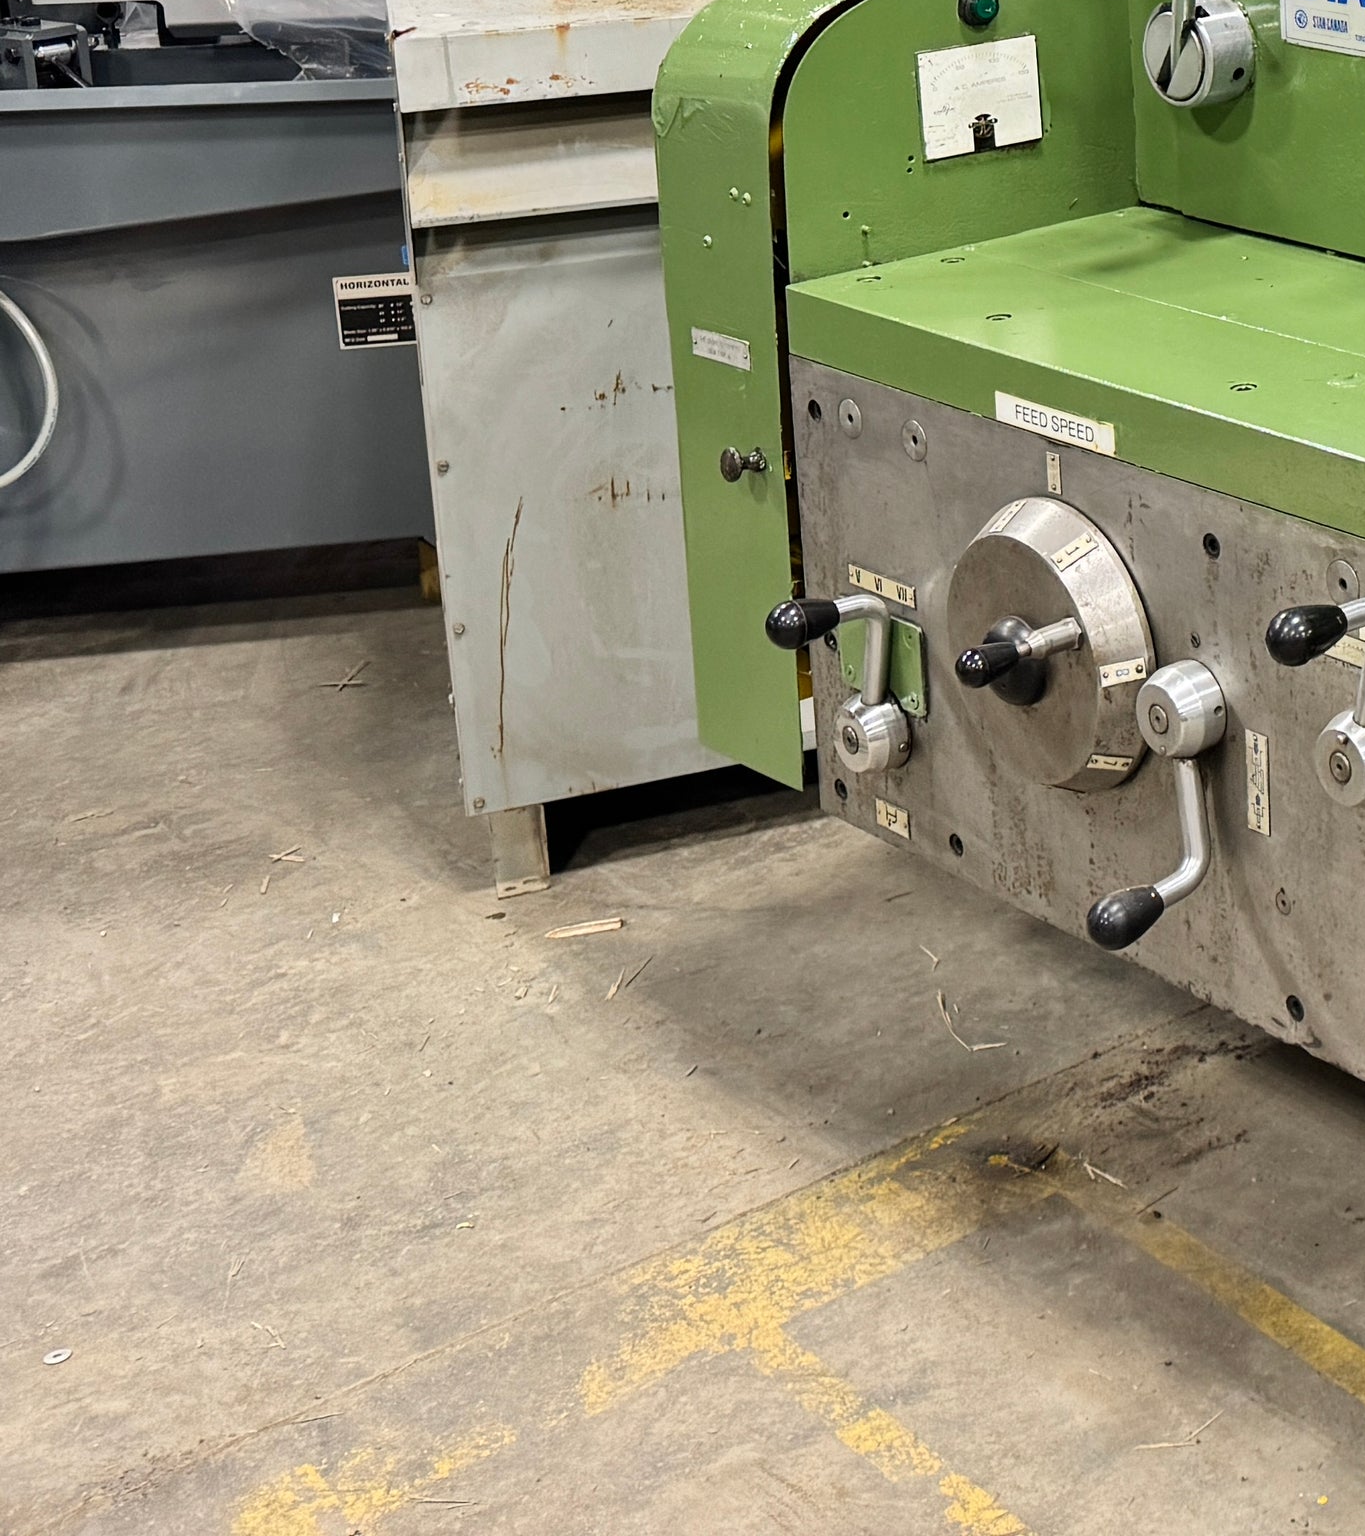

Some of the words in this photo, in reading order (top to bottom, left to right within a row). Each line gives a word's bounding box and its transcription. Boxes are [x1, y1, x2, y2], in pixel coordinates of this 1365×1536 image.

[340, 278, 410, 290] HORIZONTAL
[1015, 404, 1048, 429] FEED
[1051, 415, 1095, 443] SPEED
[855, 568, 861, 584] V
[874, 575, 883, 593] VI
[896, 584, 908, 602] VII
